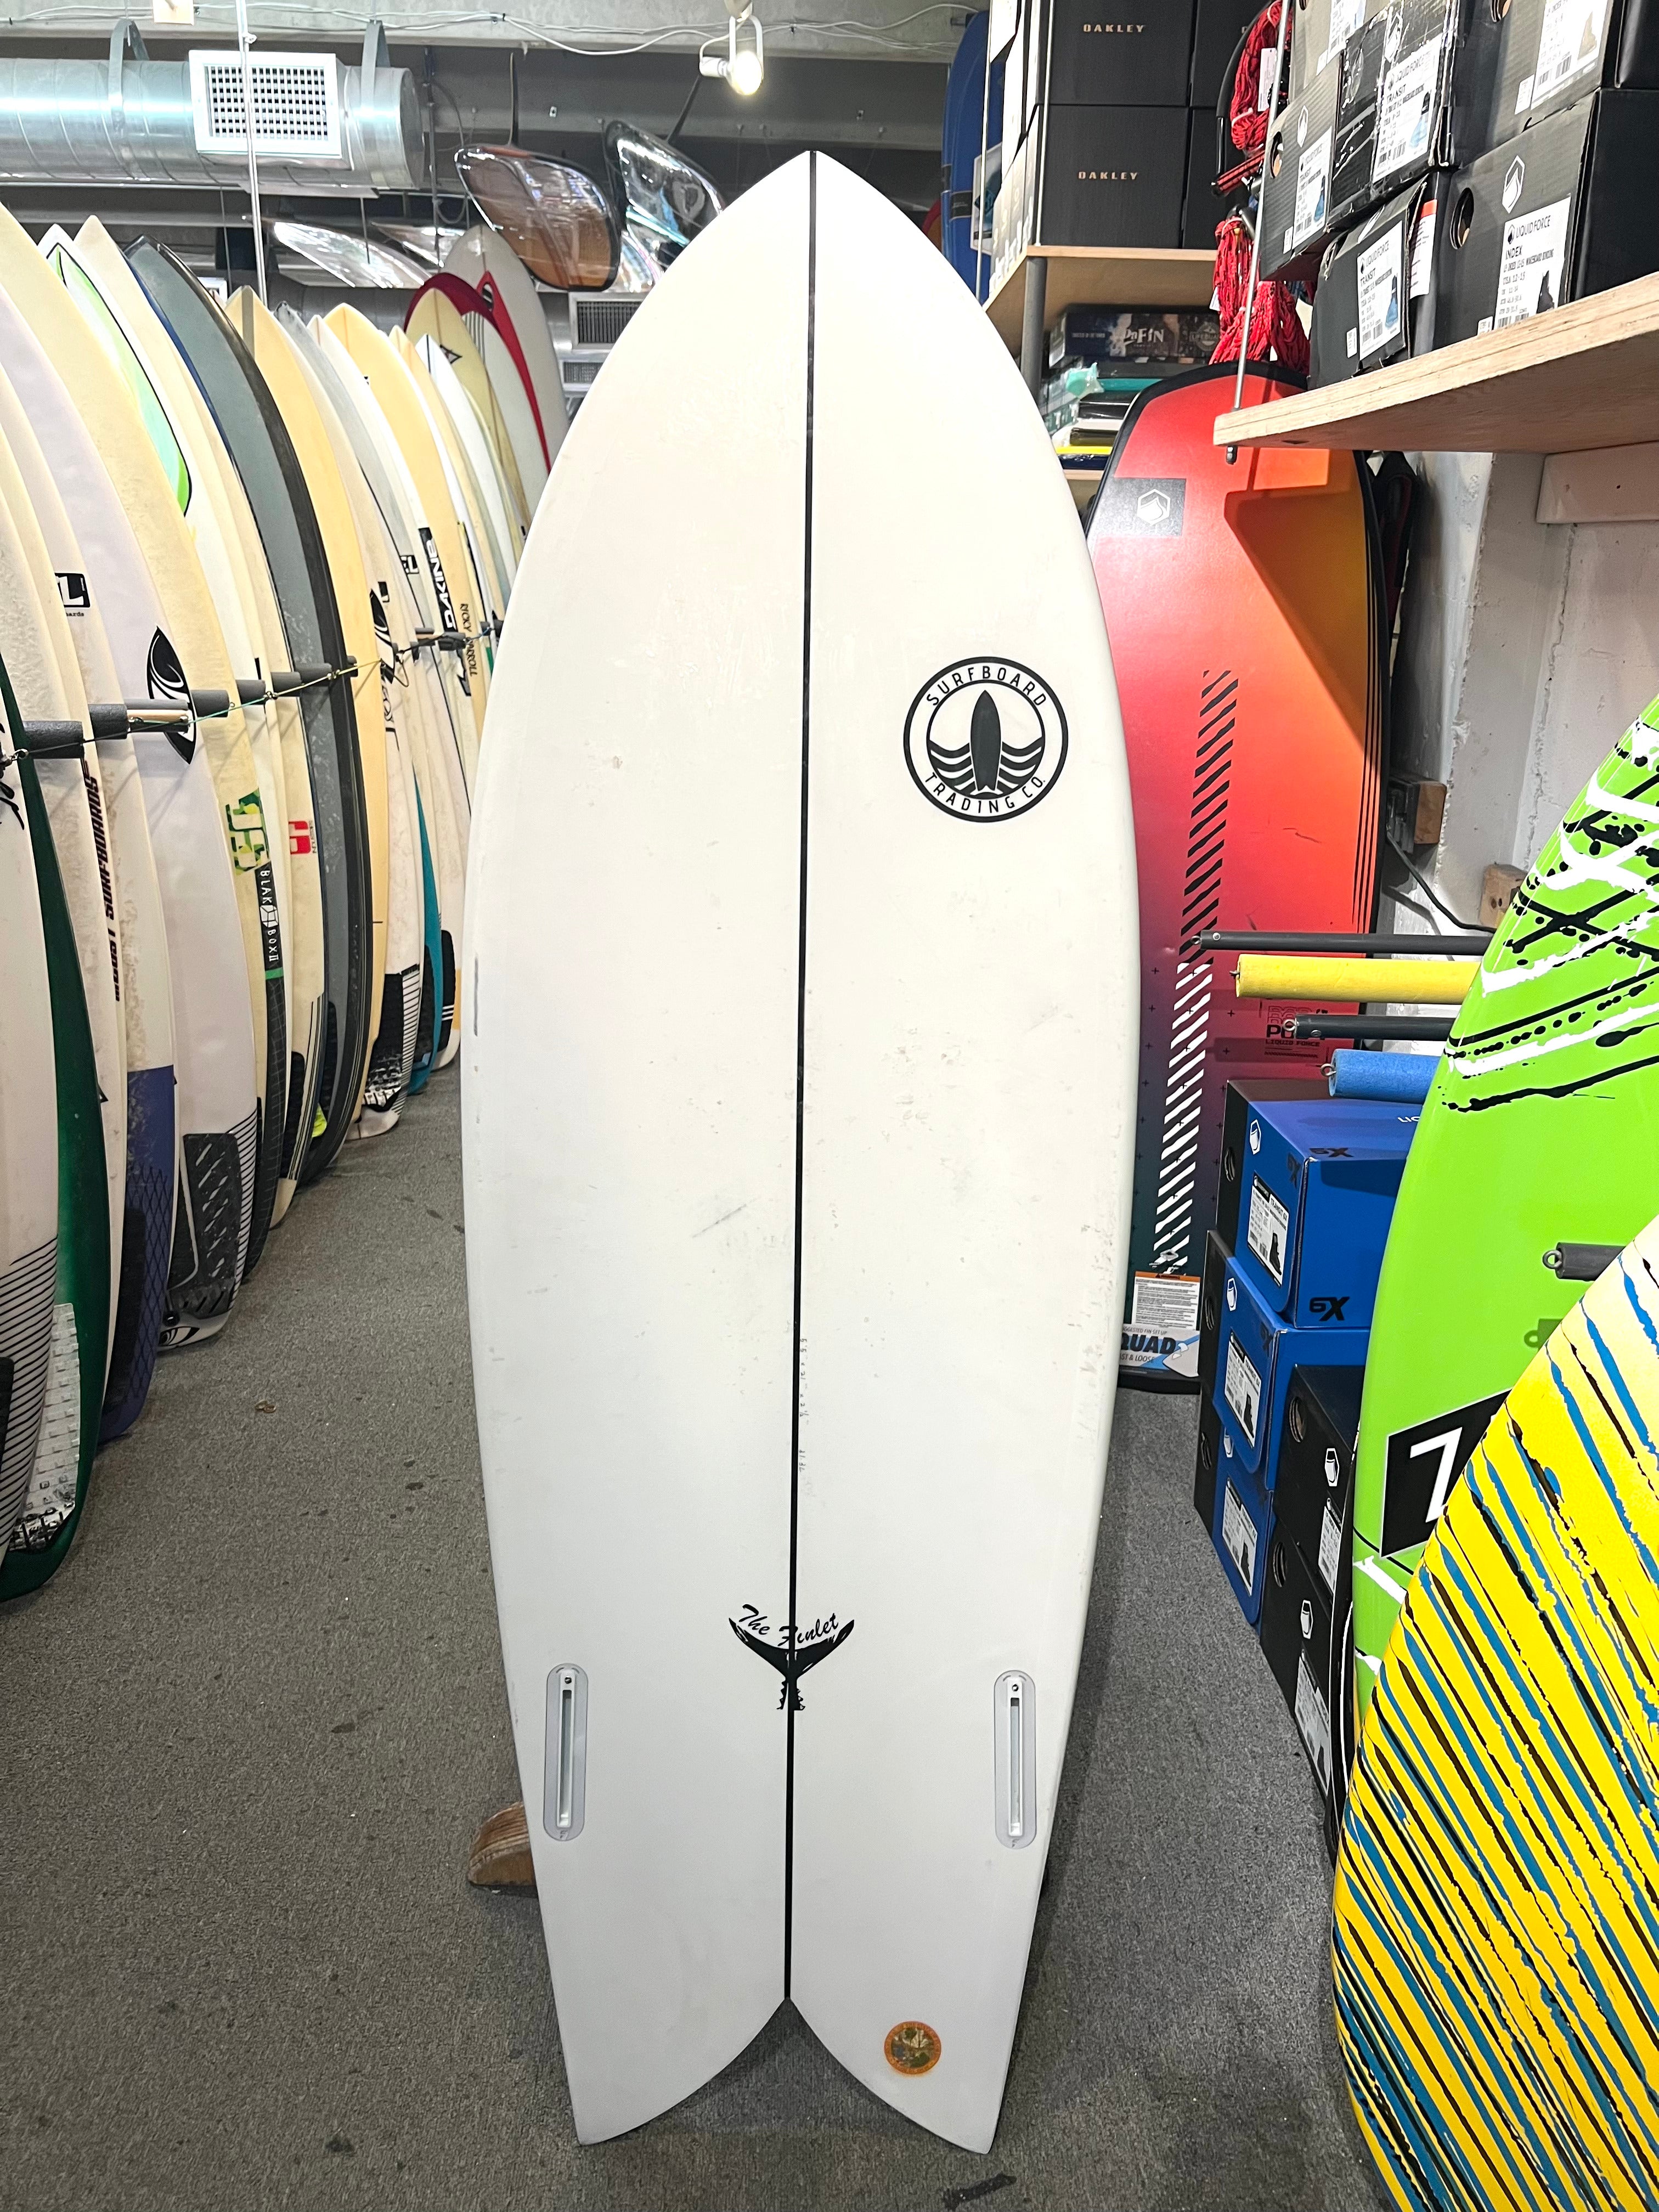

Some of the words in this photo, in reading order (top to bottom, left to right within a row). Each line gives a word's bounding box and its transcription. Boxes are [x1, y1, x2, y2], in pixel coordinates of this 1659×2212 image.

[1083, 24, 1145, 33] OAKLEY
[1078, 171, 1138, 180] OAKLEY
[1516, 222, 1533, 238] LIQUID
[1533, 215, 1551, 232] FORCE
[1505, 245, 1523, 260] INDEX
[426, 538, 456, 629] DAKINE
[466, 639, 478, 677] ARROLL
[926, 665, 1047, 706] SURFBOARD
[924, 772, 1015, 814] TRADING
[1022, 776, 1046, 798] CO.
[260, 870, 272, 904] BLAK
[1310, 1296, 1350, 1322] 6X
[1121, 1333, 1176, 1355] QUAD
[738, 1604, 771, 1635] The
